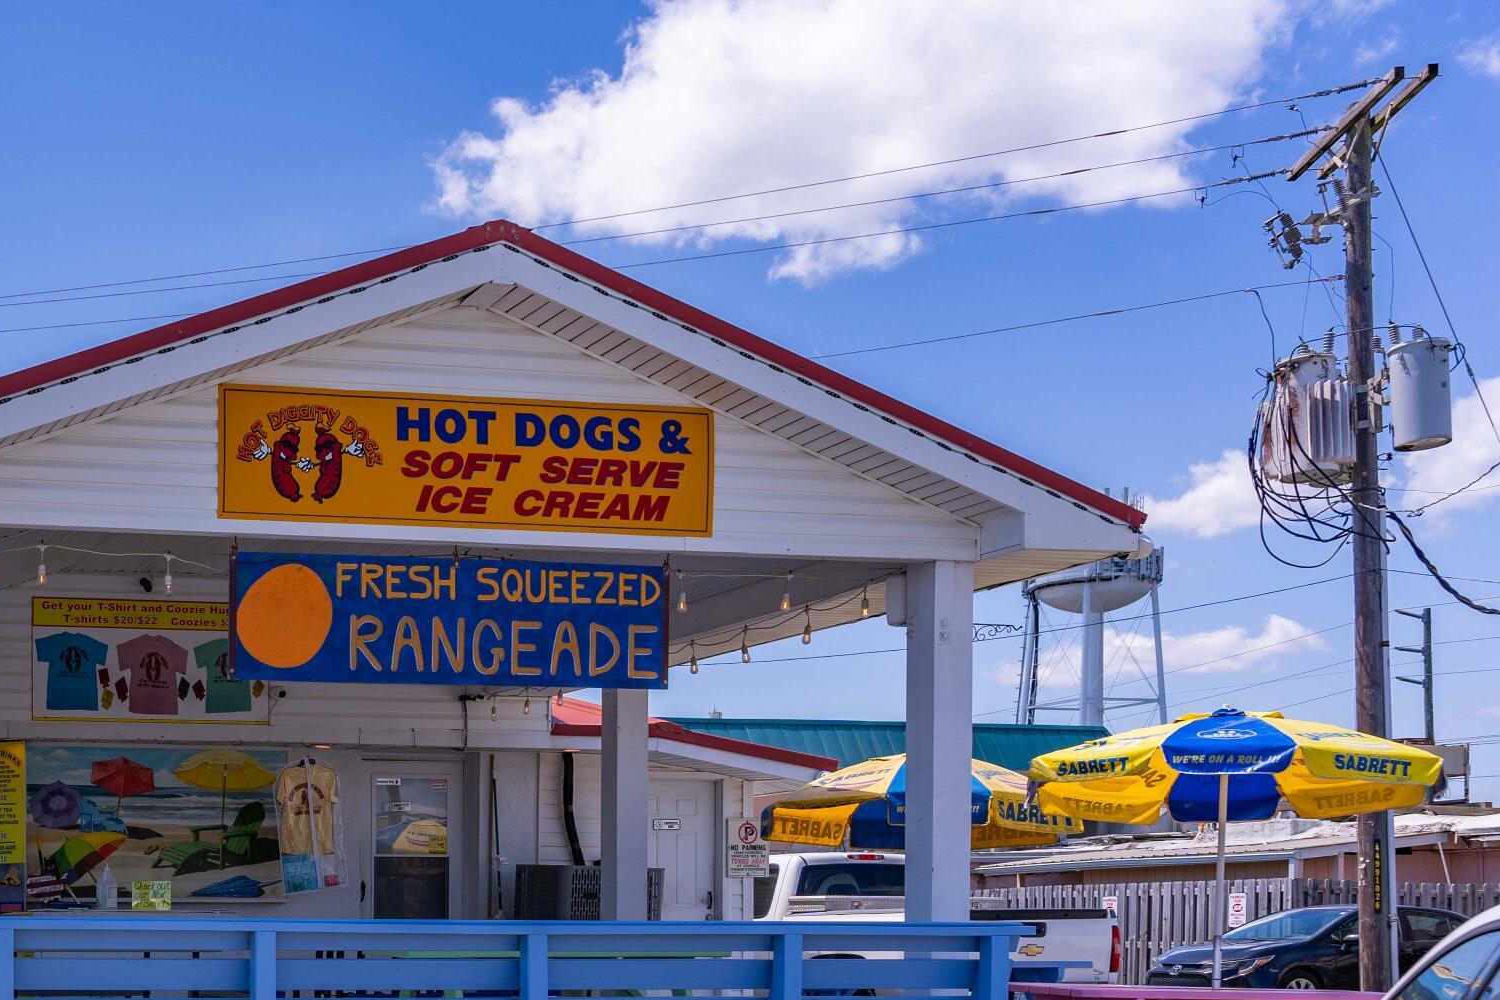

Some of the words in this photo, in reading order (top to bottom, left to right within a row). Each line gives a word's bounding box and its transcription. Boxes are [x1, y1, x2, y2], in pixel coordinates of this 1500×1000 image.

[237, 419, 268, 463] HOT
[267, 403, 340, 431] DIGGITY
[339, 415, 384, 467] DOGZ
[396, 406, 497, 445] HOT
[514, 412, 642, 452] DOGS
[658, 419, 693, 455] &
[401, 449, 522, 482] SOFT
[539, 455, 686, 489] SERVE
[415, 485, 494, 515] ICE
[513, 489, 671, 522] CREAM
[336, 562, 456, 601] FRESH
[476, 567, 661, 607] SQUEEZED
[42, 601, 63, 611] Get
[67, 602, 93, 613] your
[99, 602, 137, 613] T-Shirt
[140, 604, 162, 614] and
[166, 605, 206, 615] Coozie
[63, 615, 109, 625] T-shirts
[114, 615, 158, 626] $20/$22
[171, 617, 216, 628] Coozies
[350, 614, 658, 680] RANGEADE
[1057, 756, 1129, 777] SABRETT
[1172, 754, 1206, 764] WE'RE
[1208, 755, 1224, 764] ON
[1226, 755, 1234, 764] A
[1237, 755, 1264, 764] ROLL
[1334, 753, 1412, 777] SABRETT
